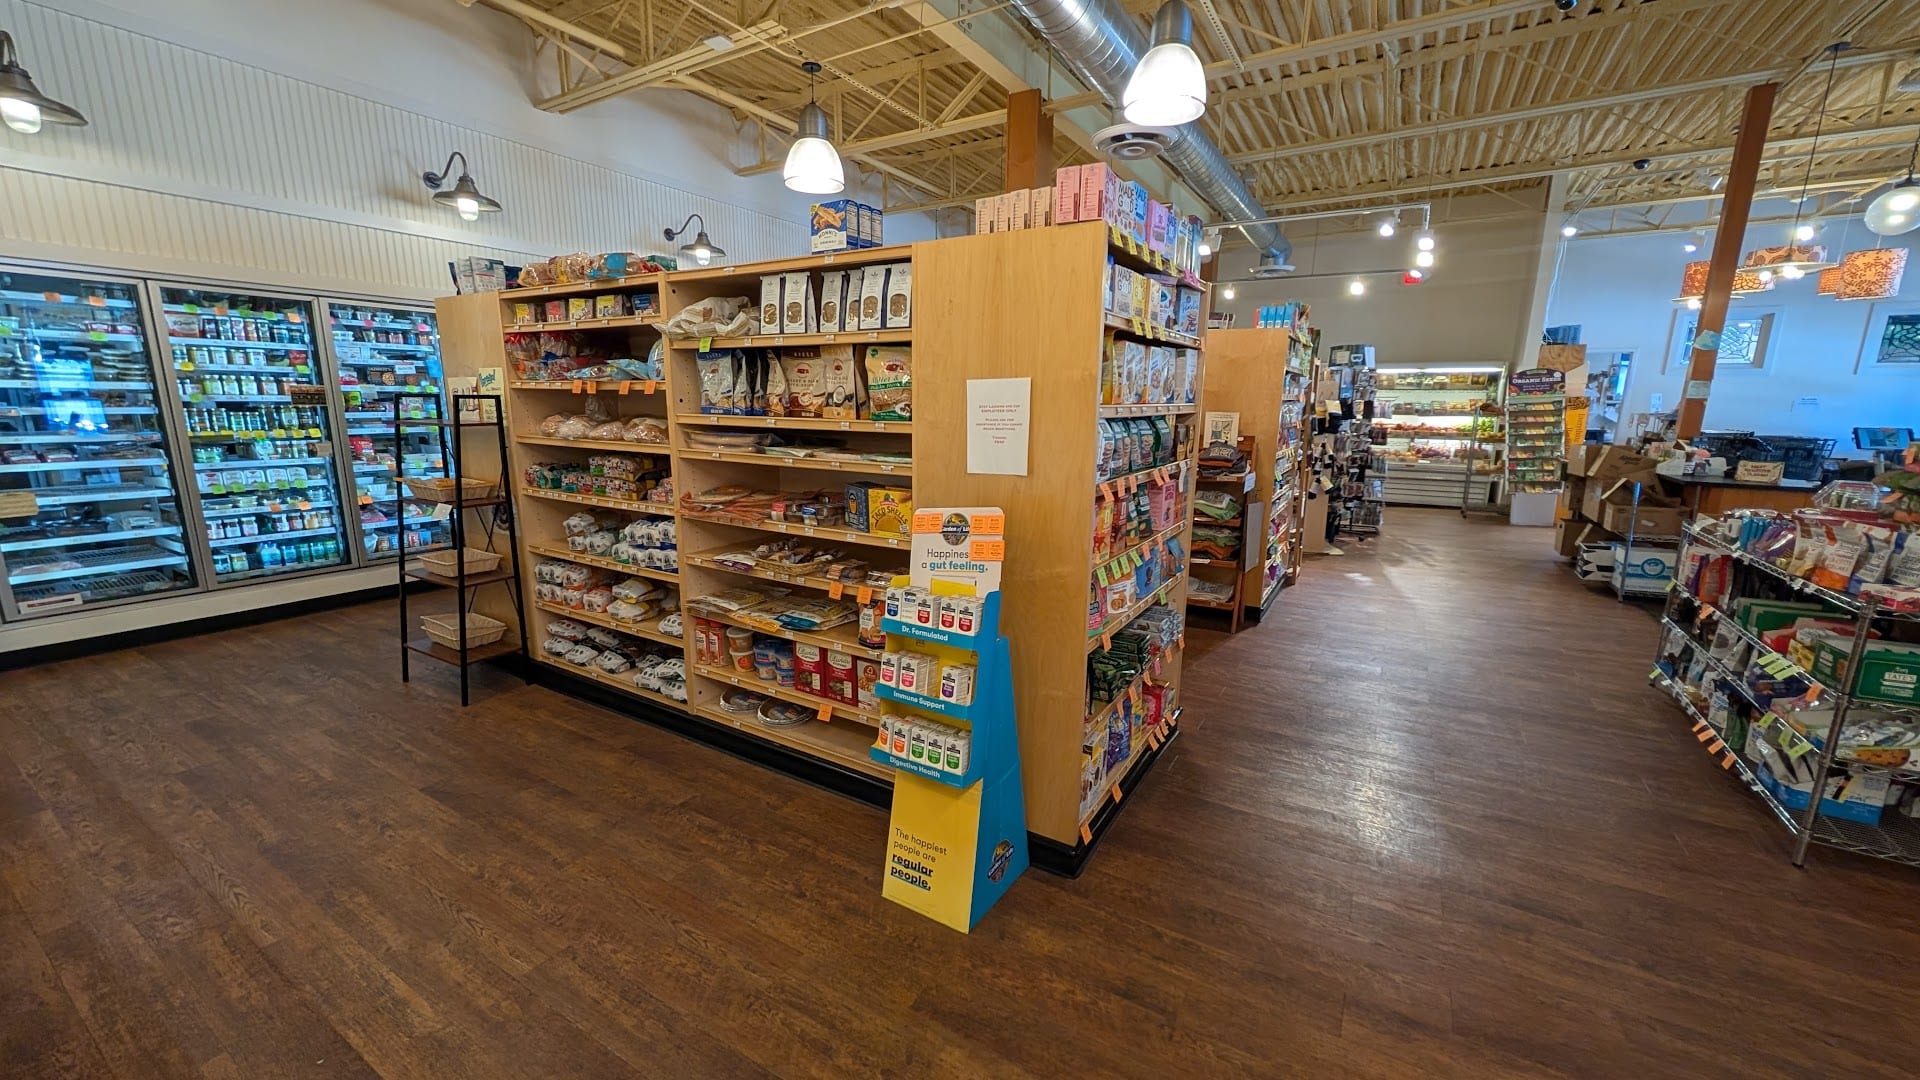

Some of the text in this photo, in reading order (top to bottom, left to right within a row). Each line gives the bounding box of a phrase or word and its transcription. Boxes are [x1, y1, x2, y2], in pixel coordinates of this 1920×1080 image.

[1118, 181, 1134, 198] MADE
[1118, 267, 1133, 282] MADE
[872, 507, 886, 521] TACO
[886, 505, 908, 525] SHELLS
[926, 548, 969, 560] Happines
[929, 561, 947, 571] gut
[949, 560, 988, 573] feeling.
[902, 625, 948, 641] Dr. Formulated
[1887, 673, 1914, 682] TATE'S
[893, 690, 945, 710] Immune Support
[889, 756, 940, 778] Digestive Health
[895, 827, 947, 856] The happiest
[893, 841, 936, 863] people are
[892, 853, 933, 877] regular
[891, 866, 931, 891] people.
